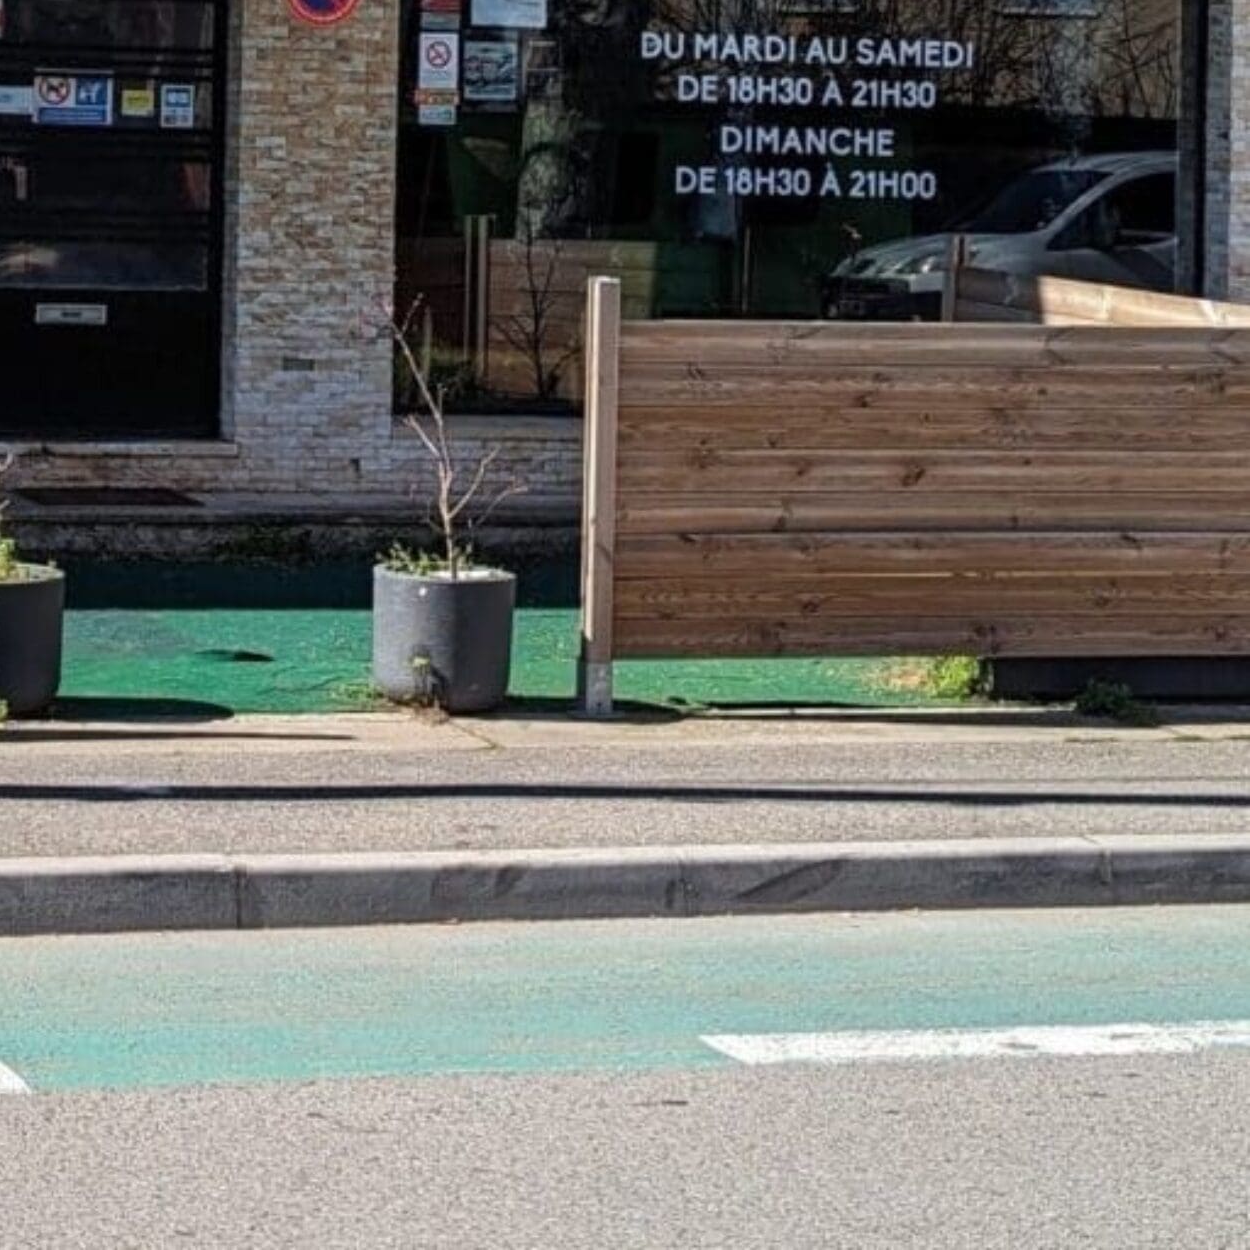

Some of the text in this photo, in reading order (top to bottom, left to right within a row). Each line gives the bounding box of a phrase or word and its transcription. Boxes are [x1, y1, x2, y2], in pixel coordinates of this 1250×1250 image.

[641, 31, 973, 68] DU MARDI AU SAMEDI
[678, 71, 937, 109] DE 18H30 À 21H30
[721, 126, 895, 158] DIMANCHE
[675, 161, 937, 199] DE 18H30 À 21H00
